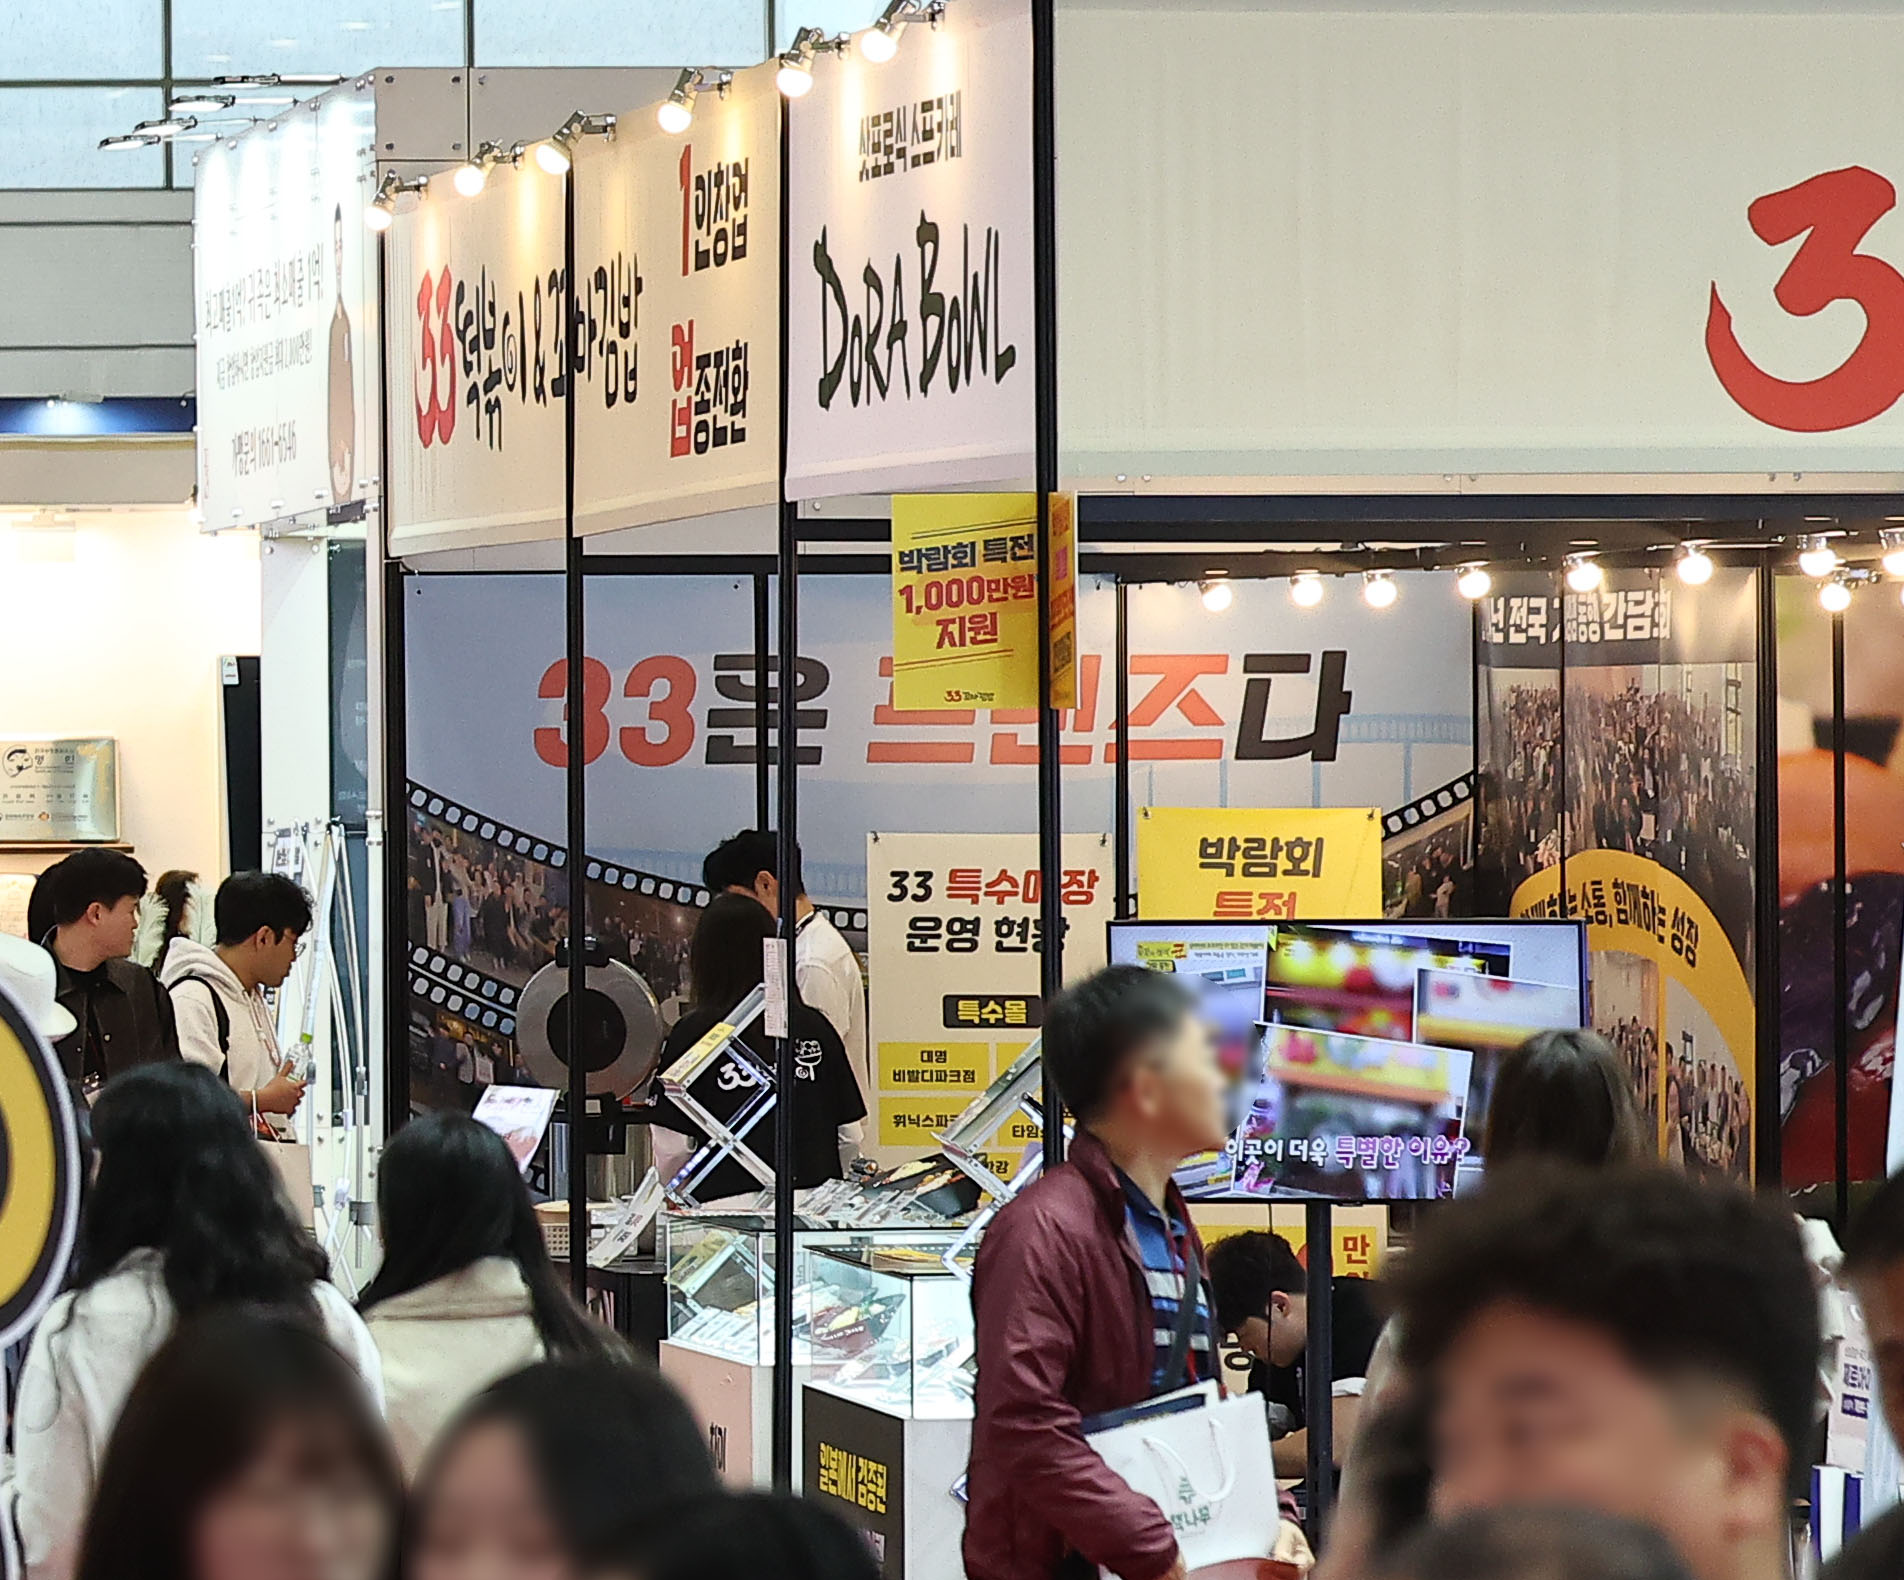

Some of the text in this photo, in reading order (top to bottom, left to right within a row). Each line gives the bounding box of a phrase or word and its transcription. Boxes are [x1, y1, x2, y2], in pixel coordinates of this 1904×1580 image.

[898, 534, 1035, 574] 박람회 특전
[898, 573, 1035, 615] 1,000만원
[936, 611, 998, 649] 지원
[1198, 835, 1325, 880] 박람회
[886, 870, 934, 902] 33
[905, 916, 981, 952] 운영
[957, 1000, 1028, 1025] 특수몰
[920, 1050, 947, 1064] 대명
[1224, 1134, 1472, 1169] 이곳이 더욱 특별한 이유?
